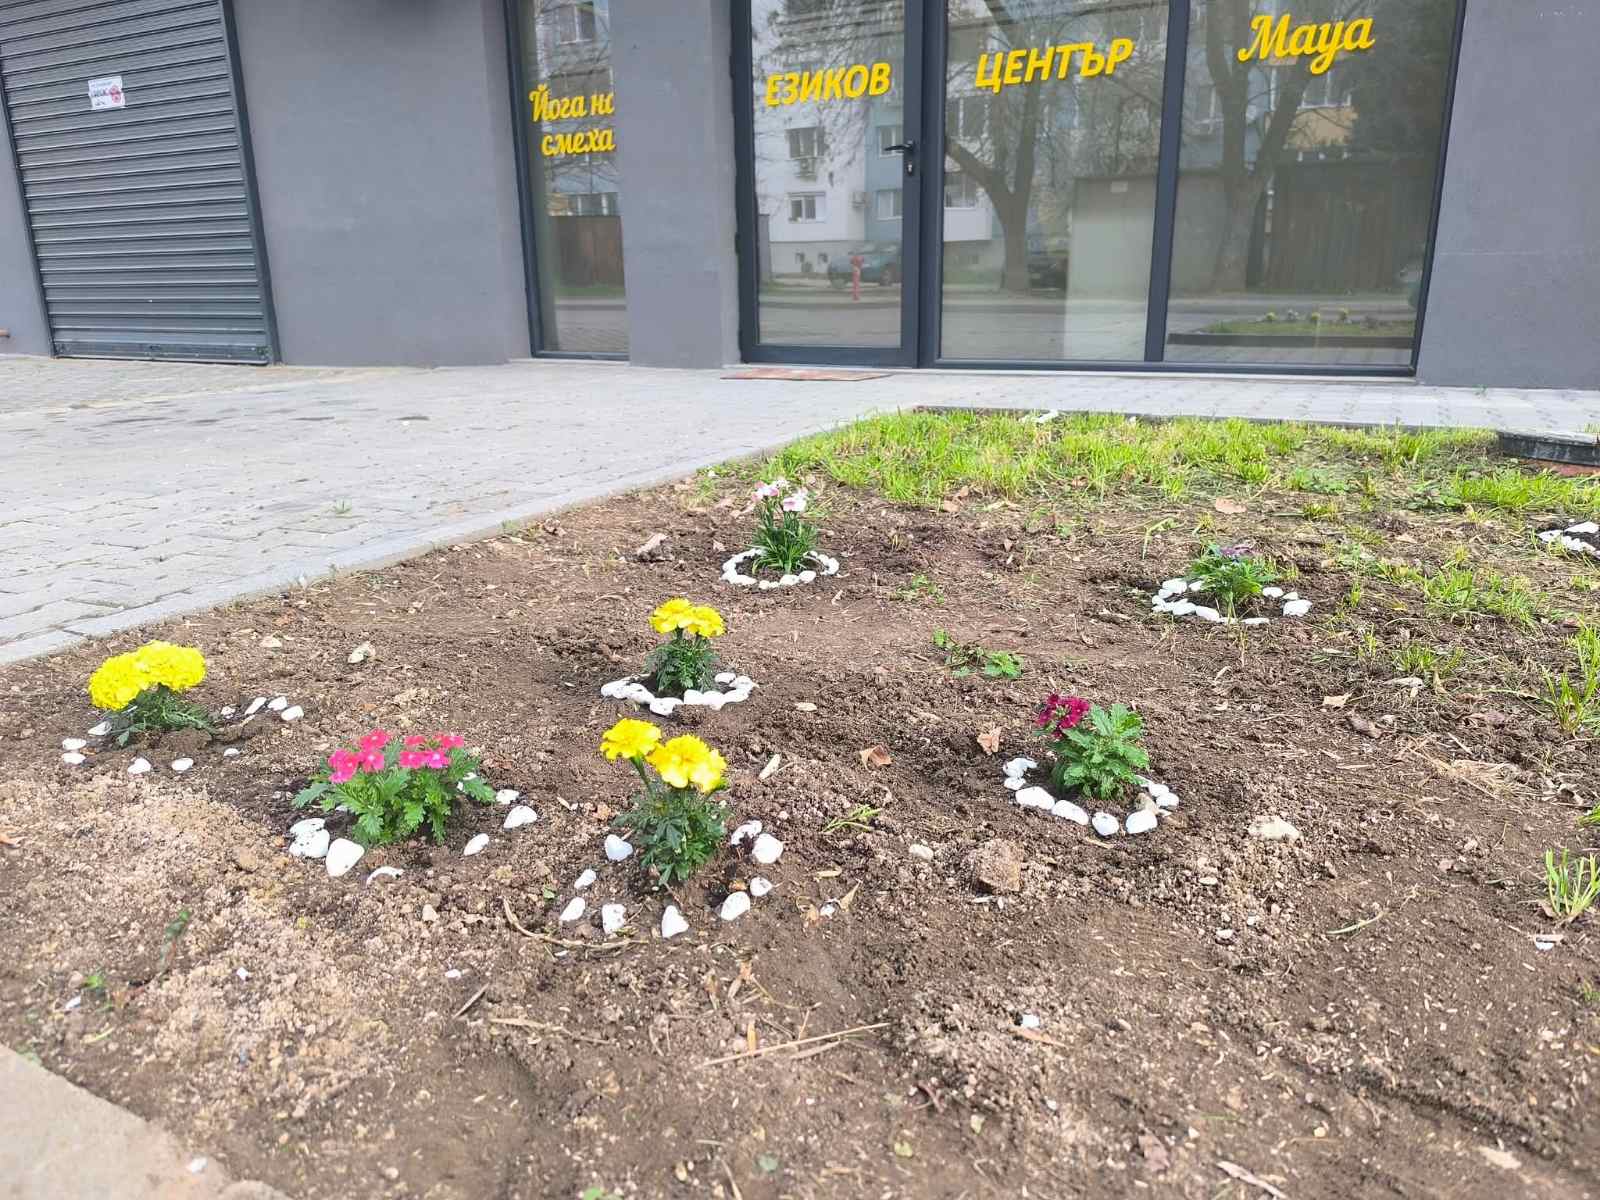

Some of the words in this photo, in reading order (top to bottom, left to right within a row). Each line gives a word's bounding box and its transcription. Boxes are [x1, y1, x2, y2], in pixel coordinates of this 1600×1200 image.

[765, 62, 893, 107] ЕЗИКОВ
[975, 37, 1135, 94] ЦЕНТЪР
[529, 84, 587, 122] Йога
[541, 129, 616, 156] смеха
